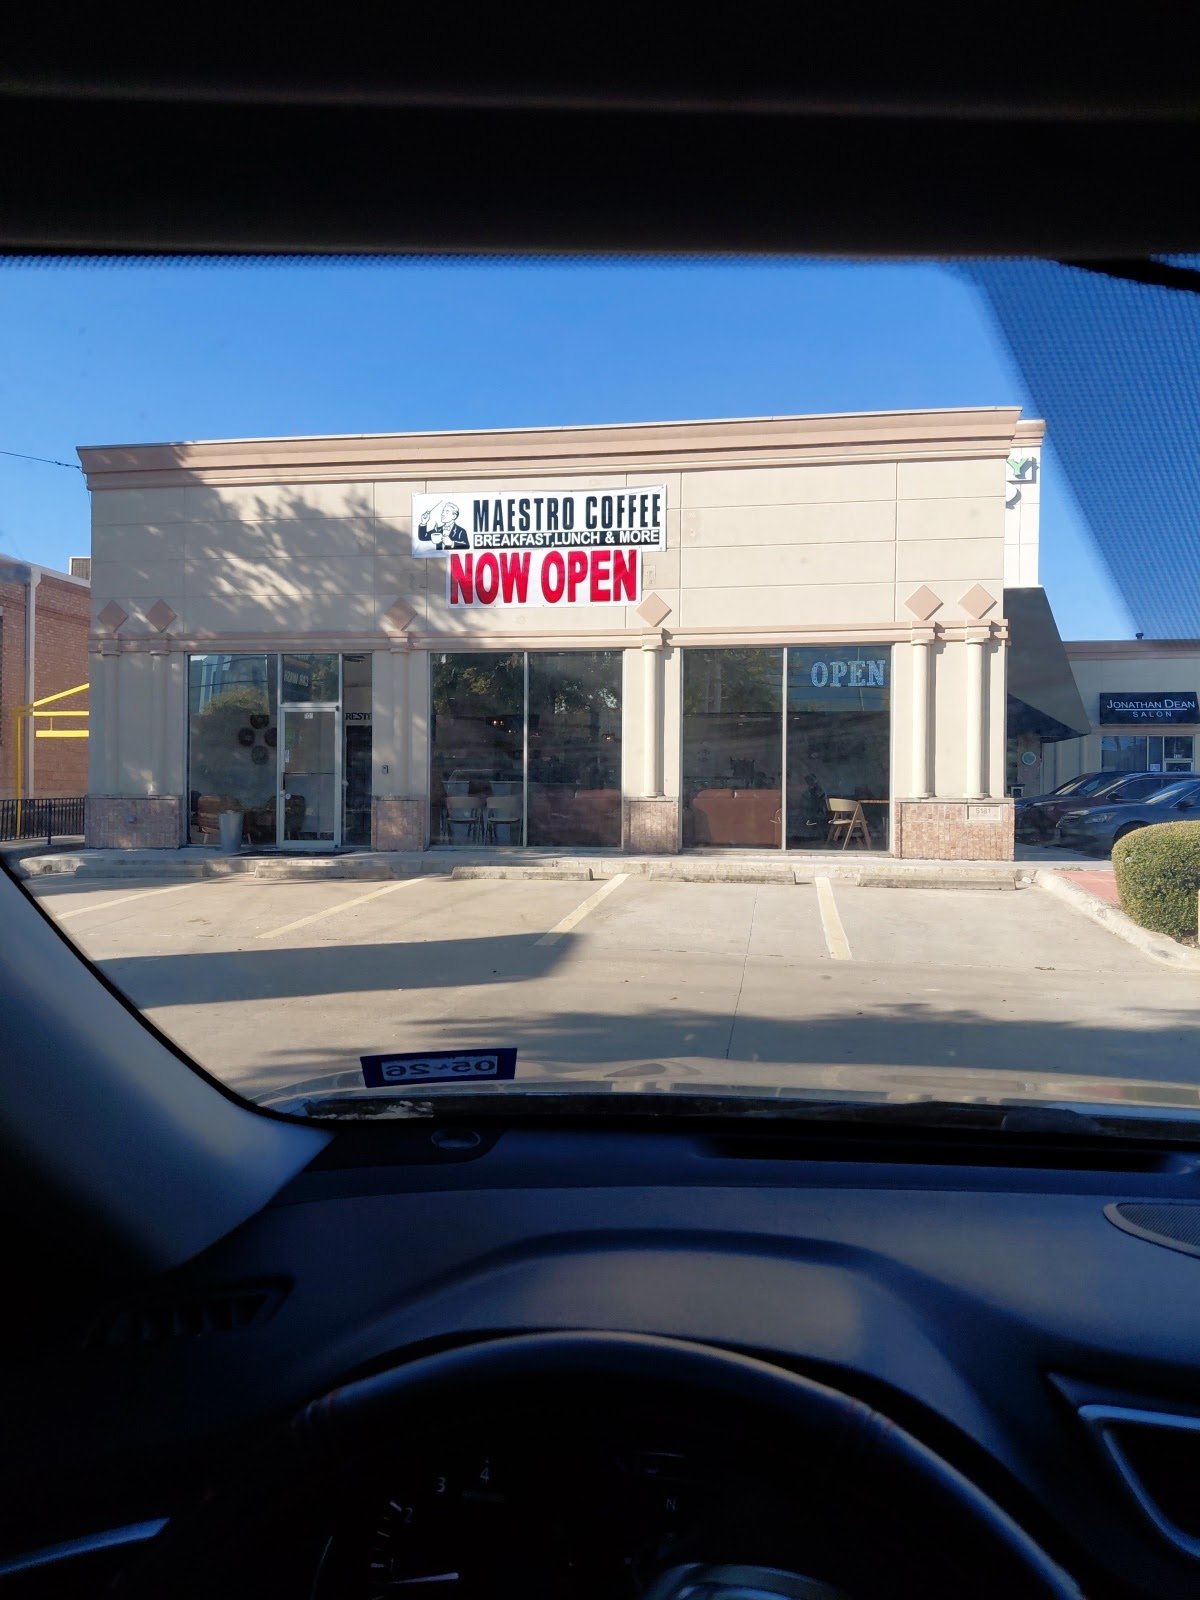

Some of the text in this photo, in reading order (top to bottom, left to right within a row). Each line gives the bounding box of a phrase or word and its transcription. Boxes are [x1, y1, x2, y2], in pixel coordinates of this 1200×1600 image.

[473, 493, 661, 532] MAESTRO COFFEE
[605, 531, 615, 544] &
[619, 530, 660, 544] MORE
[450, 549, 638, 605] NOW OPEN
[811, 660, 886, 687] OPEN
[1107, 699, 1196, 709] JONATHAN DEAN
[436, 1476, 446, 1492] 3
